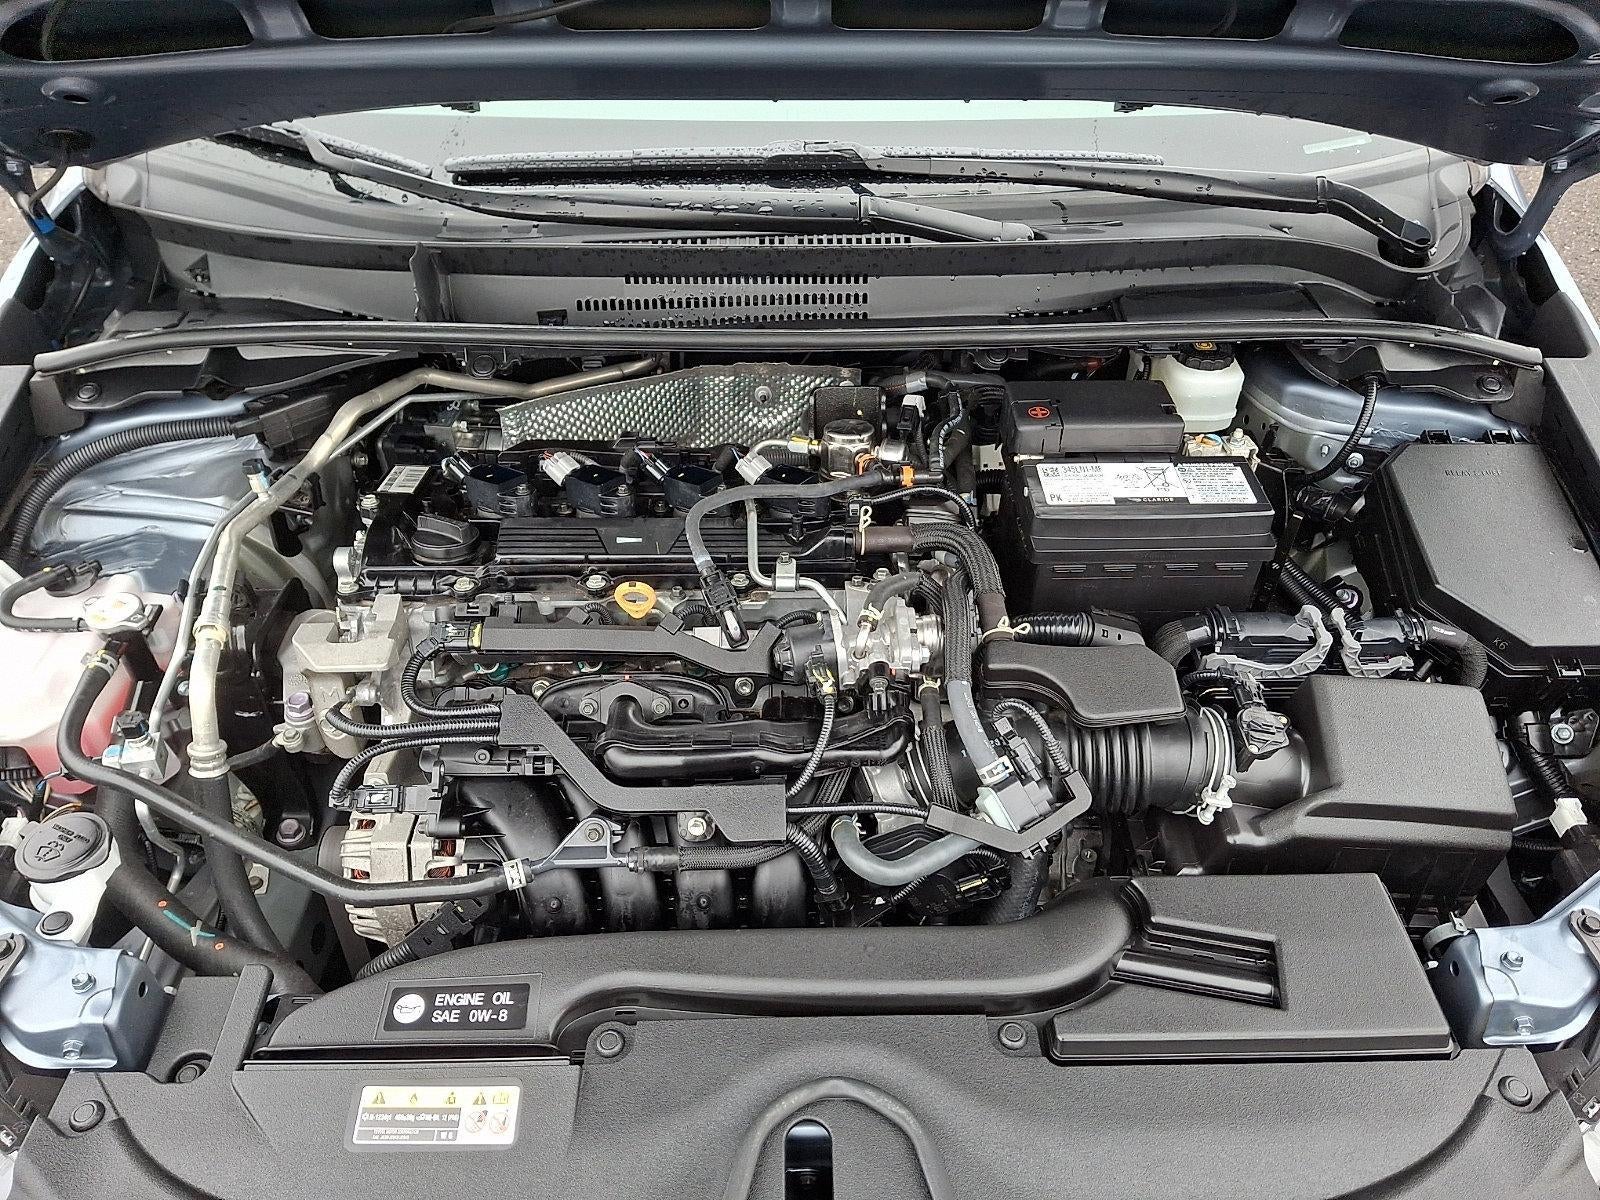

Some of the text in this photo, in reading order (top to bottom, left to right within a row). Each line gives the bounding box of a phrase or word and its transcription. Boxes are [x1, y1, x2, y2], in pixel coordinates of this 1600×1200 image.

[1049, 493, 1063, 502] PK
[434, 991, 514, 1006] ENGINE OIL
[431, 1008, 509, 1023] SAE 0W-8
